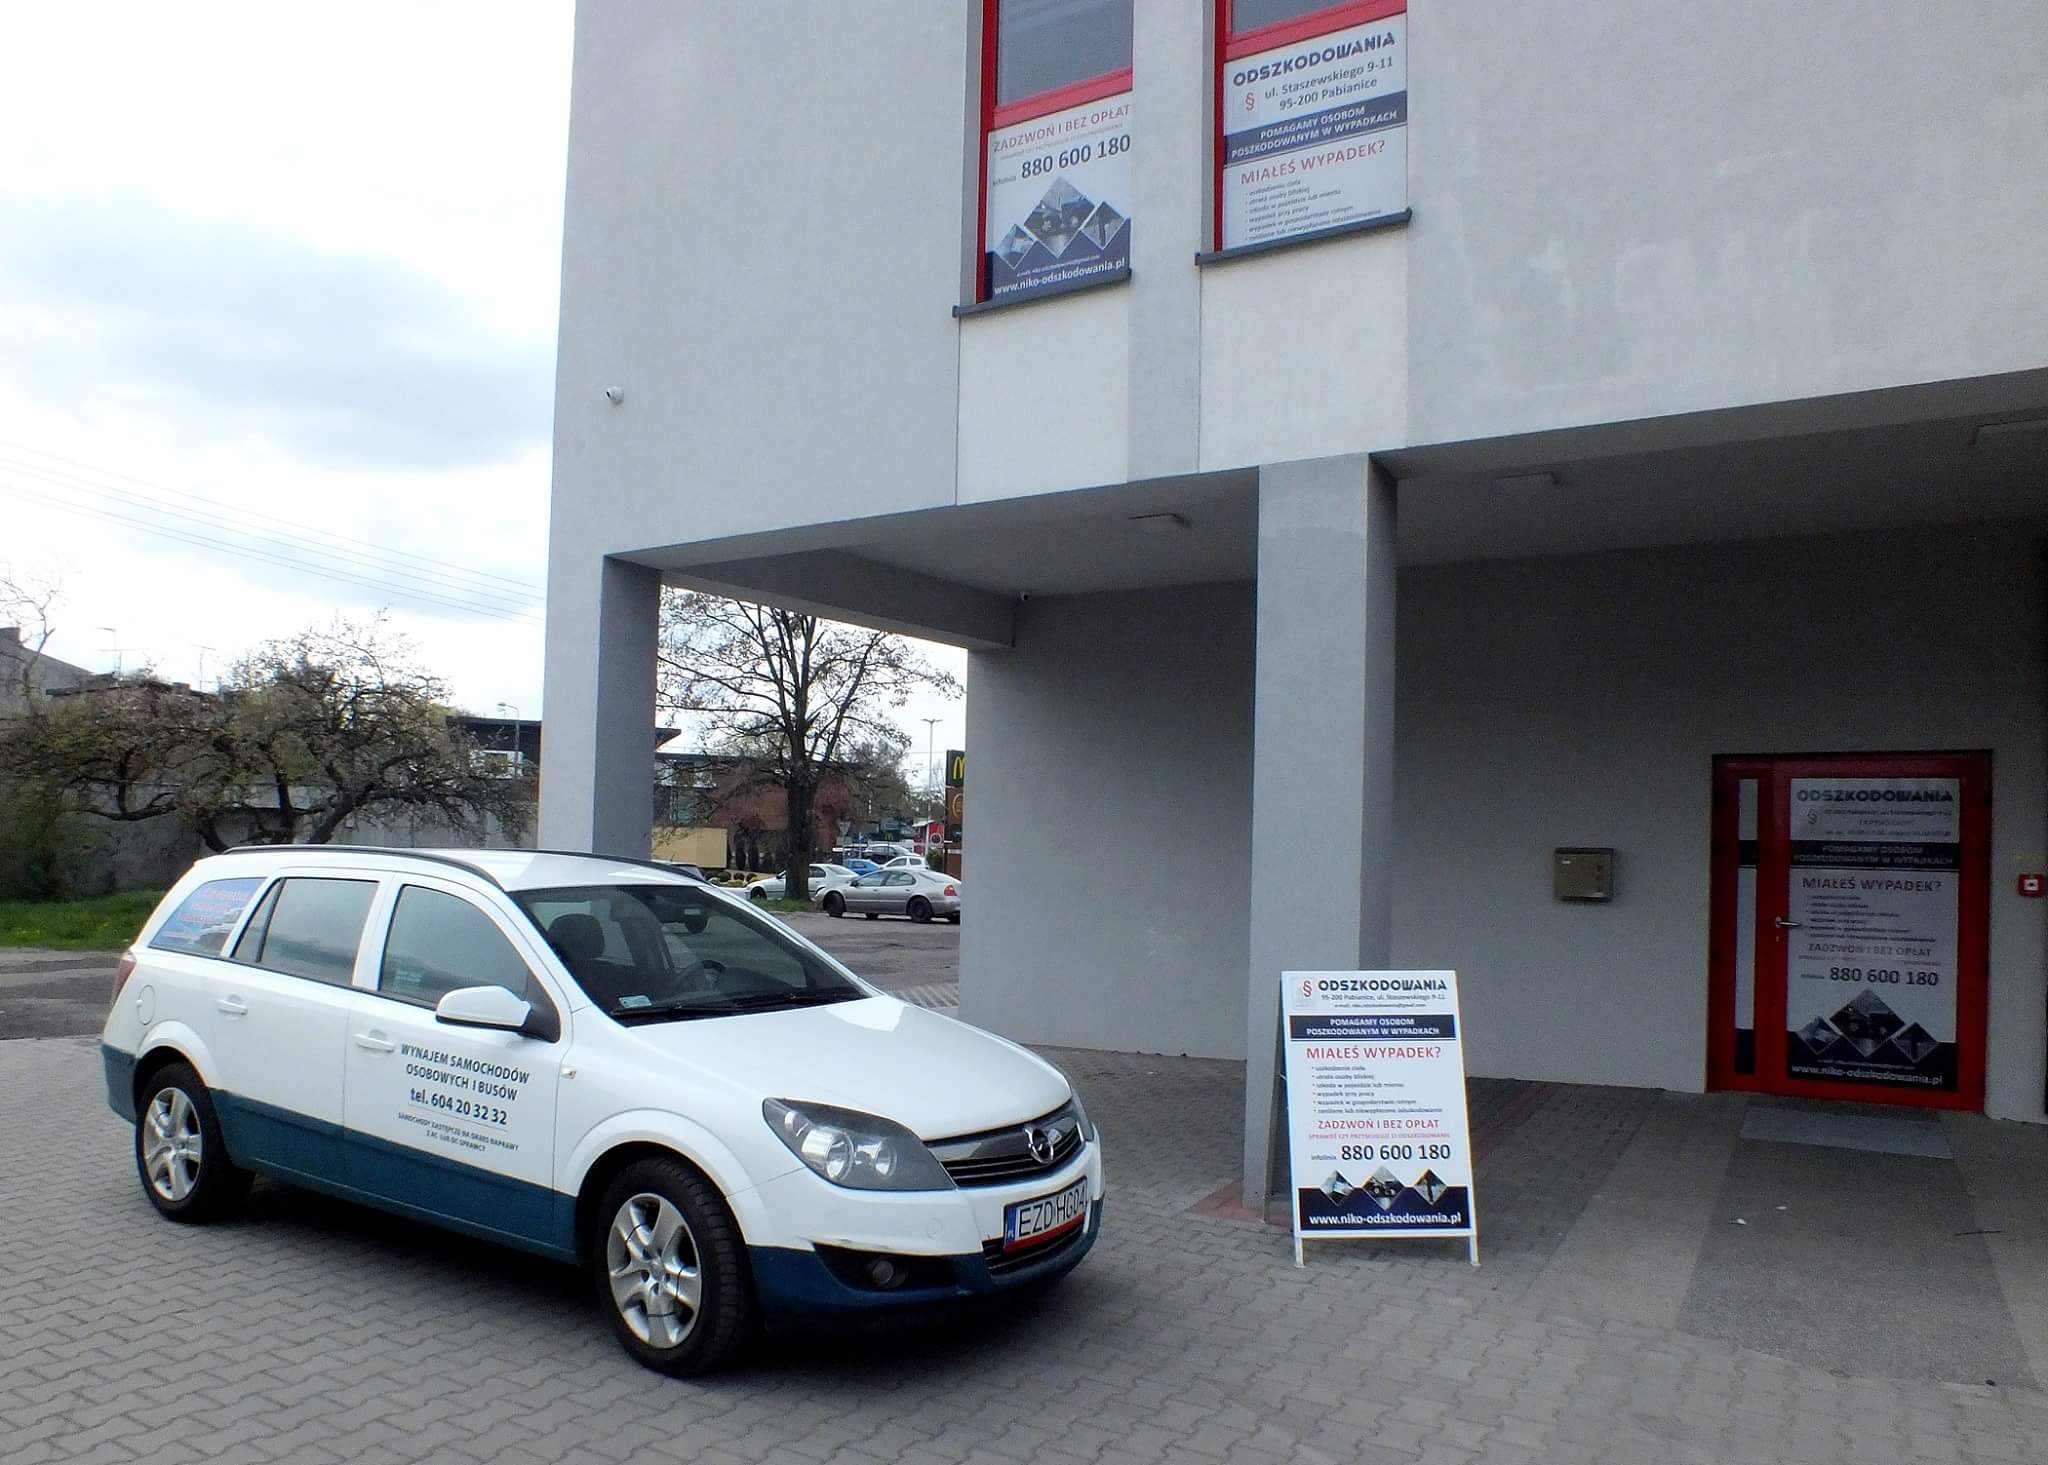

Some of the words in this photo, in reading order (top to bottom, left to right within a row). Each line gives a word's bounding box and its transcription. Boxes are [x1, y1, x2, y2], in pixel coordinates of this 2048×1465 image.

[1233, 32, 1396, 87] ODSZKODOWANIA
[1264, 87, 1279, 99] ul.
[1281, 67, 1364, 95] Staszewskiego
[1367, 56, 1393, 73] 9-11
[1279, 93, 1318, 111] 95-200
[1322, 78, 1378, 101] Pabianice
[993, 122, 1055, 152] ZADZWOŃ
[1058, 123, 1062, 134] I
[1065, 117, 1087, 132] BEZ
[1090, 104, 1131, 125] OPŁAT
[1231, 130, 1320, 158] POSZKODOWANYM
[1321, 125, 1333, 137] W
[1334, 110, 1398, 134] WYPADKACH
[1260, 117, 1318, 140] POMAGAMY
[1320, 106, 1366, 125] OSOBOM
[1021, 155, 1053, 179] 880
[1058, 144, 1091, 169] 600
[1097, 134, 1131, 159] 180
[1241, 159, 1296, 185] MIAŁEŚ
[1301, 140, 1385, 171] WYPADEK?
[994, 257, 1126, 295] www.niko-odszkodowania.pl
[1797, 790, 1954, 802] ODSZKODOWANIA
[1803, 876, 1856, 889] MIAŁEŚ
[1861, 879, 1942, 892] WYPADEK?
[1318, 979, 1448, 991] ODSZKODOWANIA
[1830, 967, 1862, 981] 880
[1867, 969, 1900, 984] 600
[1906, 971, 1938, 986] 180
[1306, 1027, 1380, 1036] POSZKODOWANYM
[1380, 1027, 1388, 1035] W
[1391, 1027, 1440, 1035] WYPADKACH
[1330, 1018, 1377, 1026] POMAGAMY
[1379, 1017, 1414, 1026] OSOBOM
[401, 1043, 449, 1065] WYNAJEM
[450, 1055, 530, 1084] SAMOCHODÓW
[1306, 1045, 1359, 1059] MIAŁEŚ
[1364, 1046, 1441, 1059] WYPADEK?
[406, 1063, 469, 1089] OSOBOWYCH
[472, 1080, 476, 1091] I
[478, 1084, 518, 1101] BUSÓW
[410, 1087, 428, 1104] tel.
[431, 1093, 453, 1111] 604
[456, 1099, 471, 1115] 20
[473, 1103, 489, 1120] 32
[492, 1108, 507, 1125] 32
[1318, 1118, 1373, 1129] ZADZWOŃ
[1376, 1120, 1380, 1129] I
[1383, 1120, 1402, 1129] BEZ
[1405, 1119, 1439, 1129] OPŁAT
[1341, 1145, 1374, 1160] 880
[1379, 1144, 1412, 1160] 600
[1418, 1144, 1450, 1160] 180
[1019, 1201, 1053, 1237] EZD
[1309, 1212, 1461, 1225] www.niko-odszkodowania.pl
